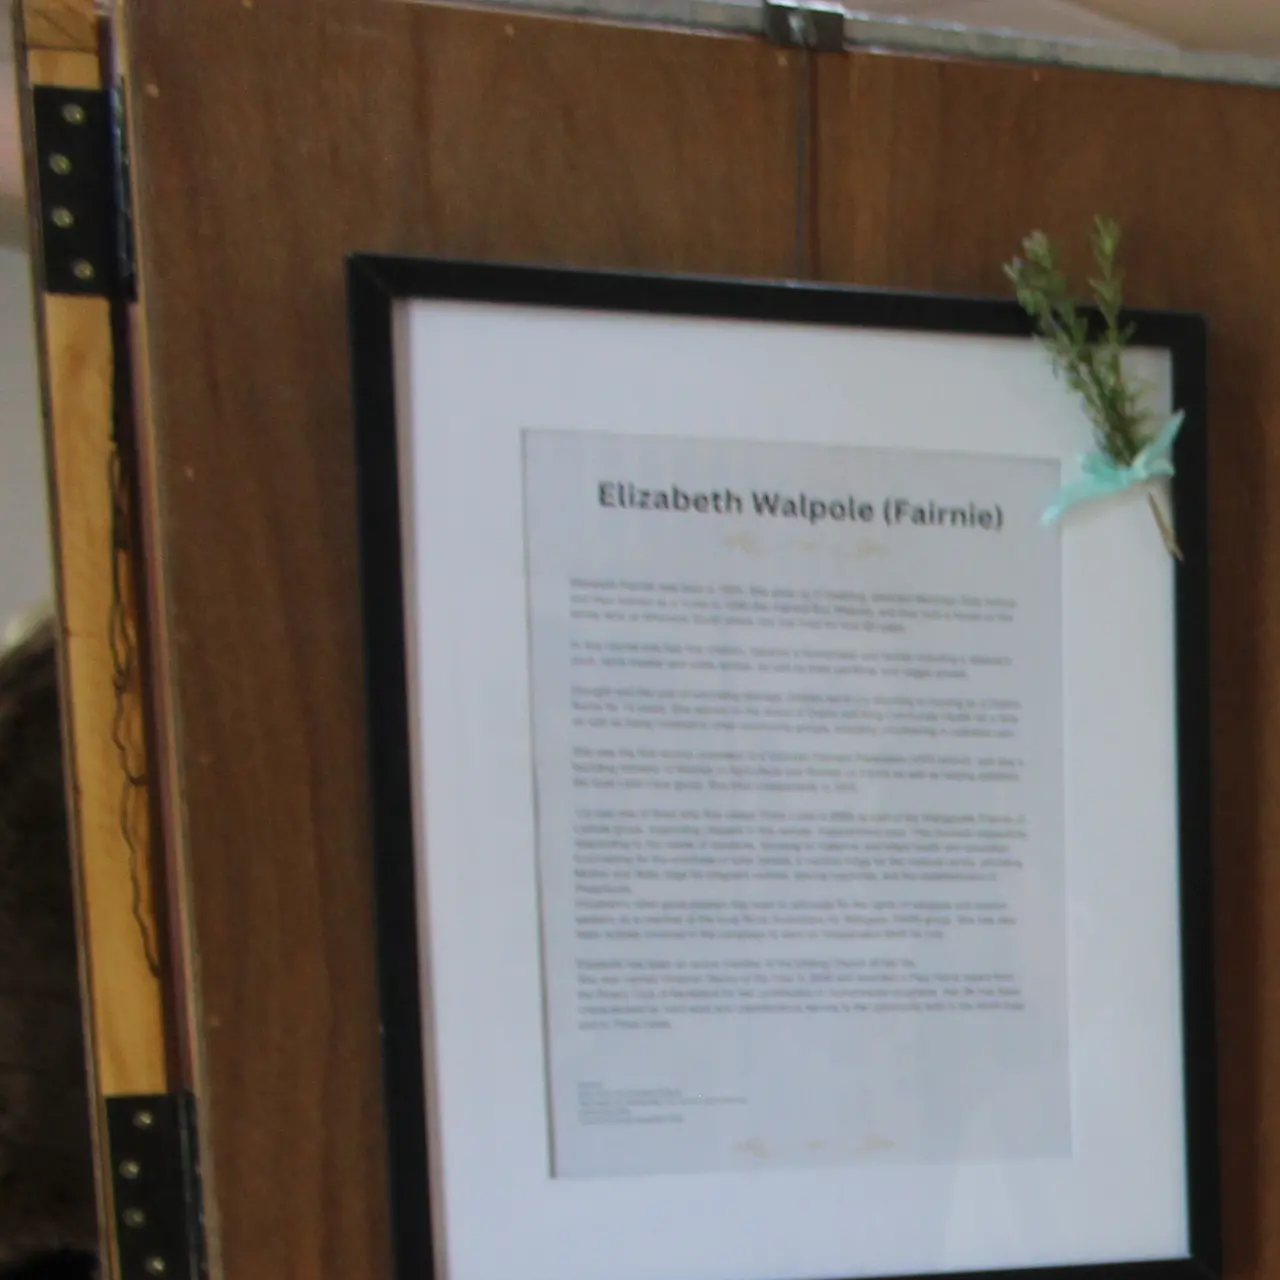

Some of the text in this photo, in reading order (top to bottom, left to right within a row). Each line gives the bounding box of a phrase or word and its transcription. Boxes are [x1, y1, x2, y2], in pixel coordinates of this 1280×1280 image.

[597, 480, 1005, 532] Elizabeth Walpole (Fairnie)
